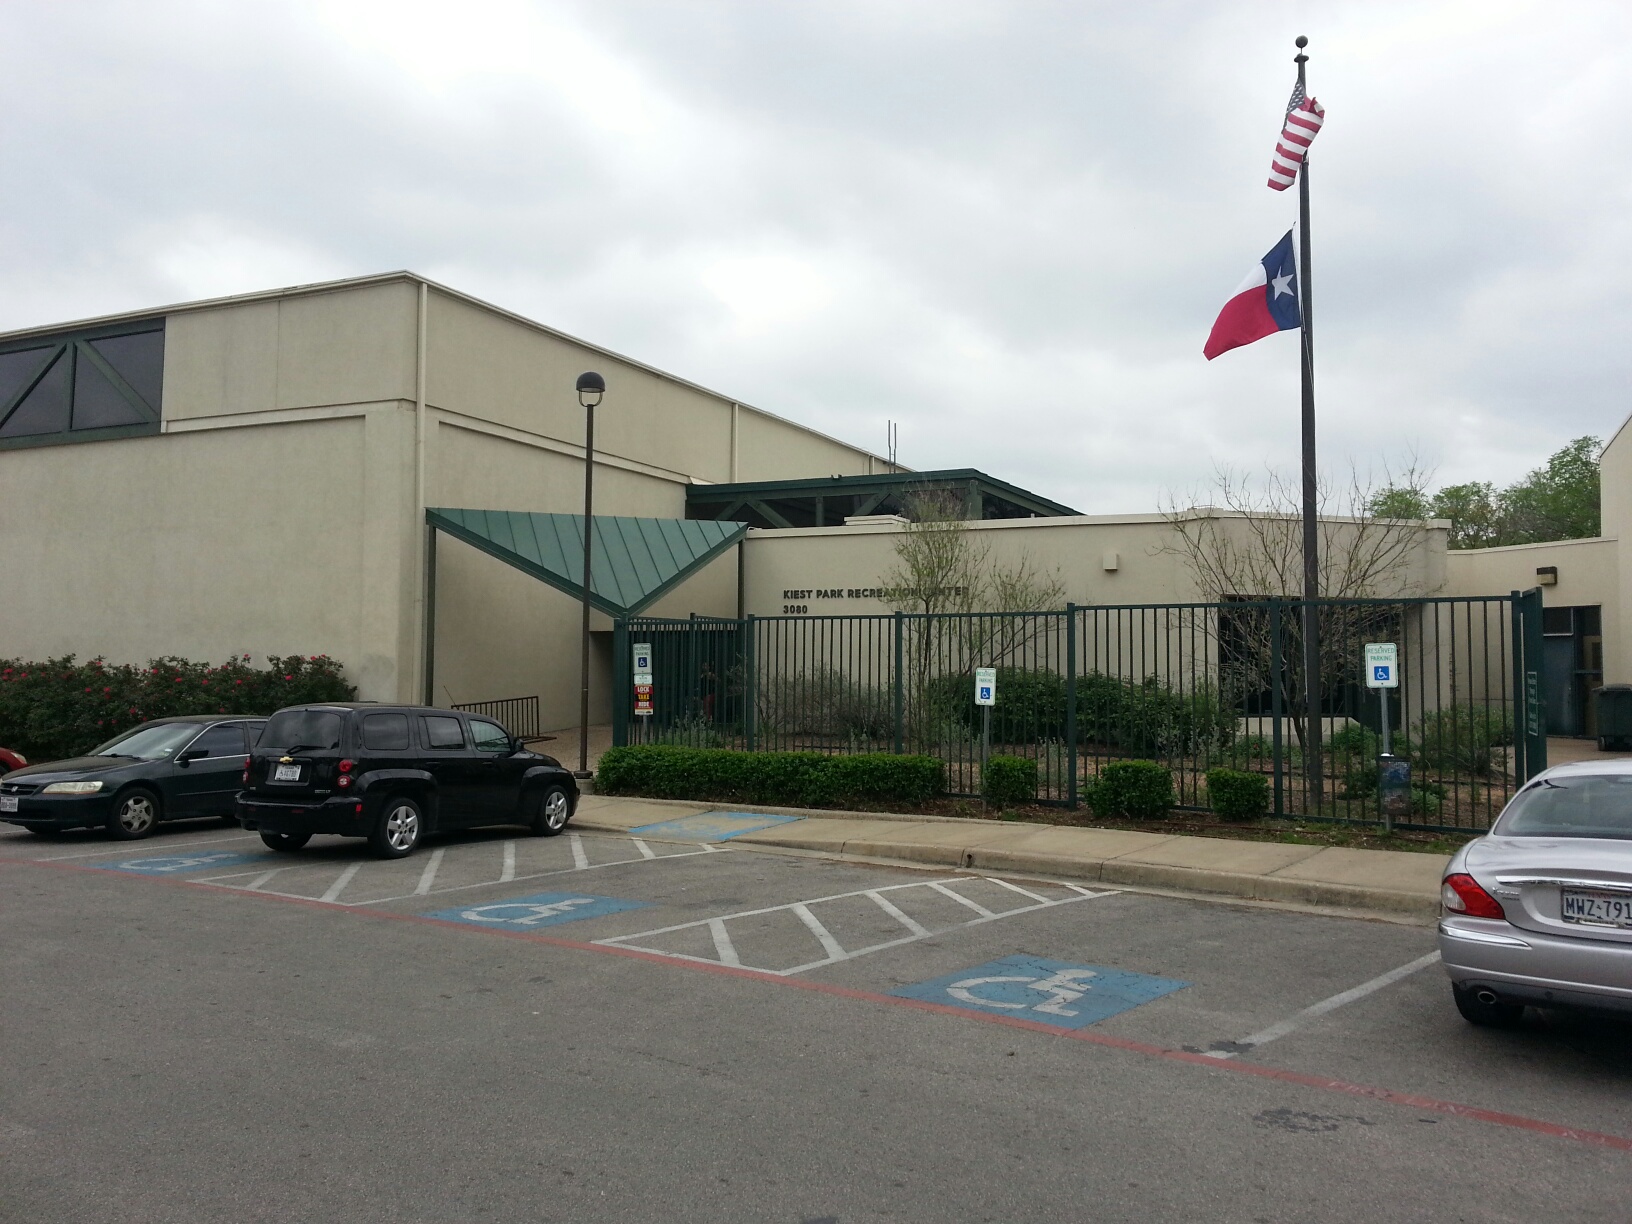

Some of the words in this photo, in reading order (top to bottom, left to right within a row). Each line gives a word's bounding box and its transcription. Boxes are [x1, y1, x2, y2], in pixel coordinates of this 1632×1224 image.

[783, 589, 813, 600] KIEST
[816, 588, 844, 599] PARK
[847, 587, 919, 599] RECREATION
[783, 605, 808, 614] 3080
